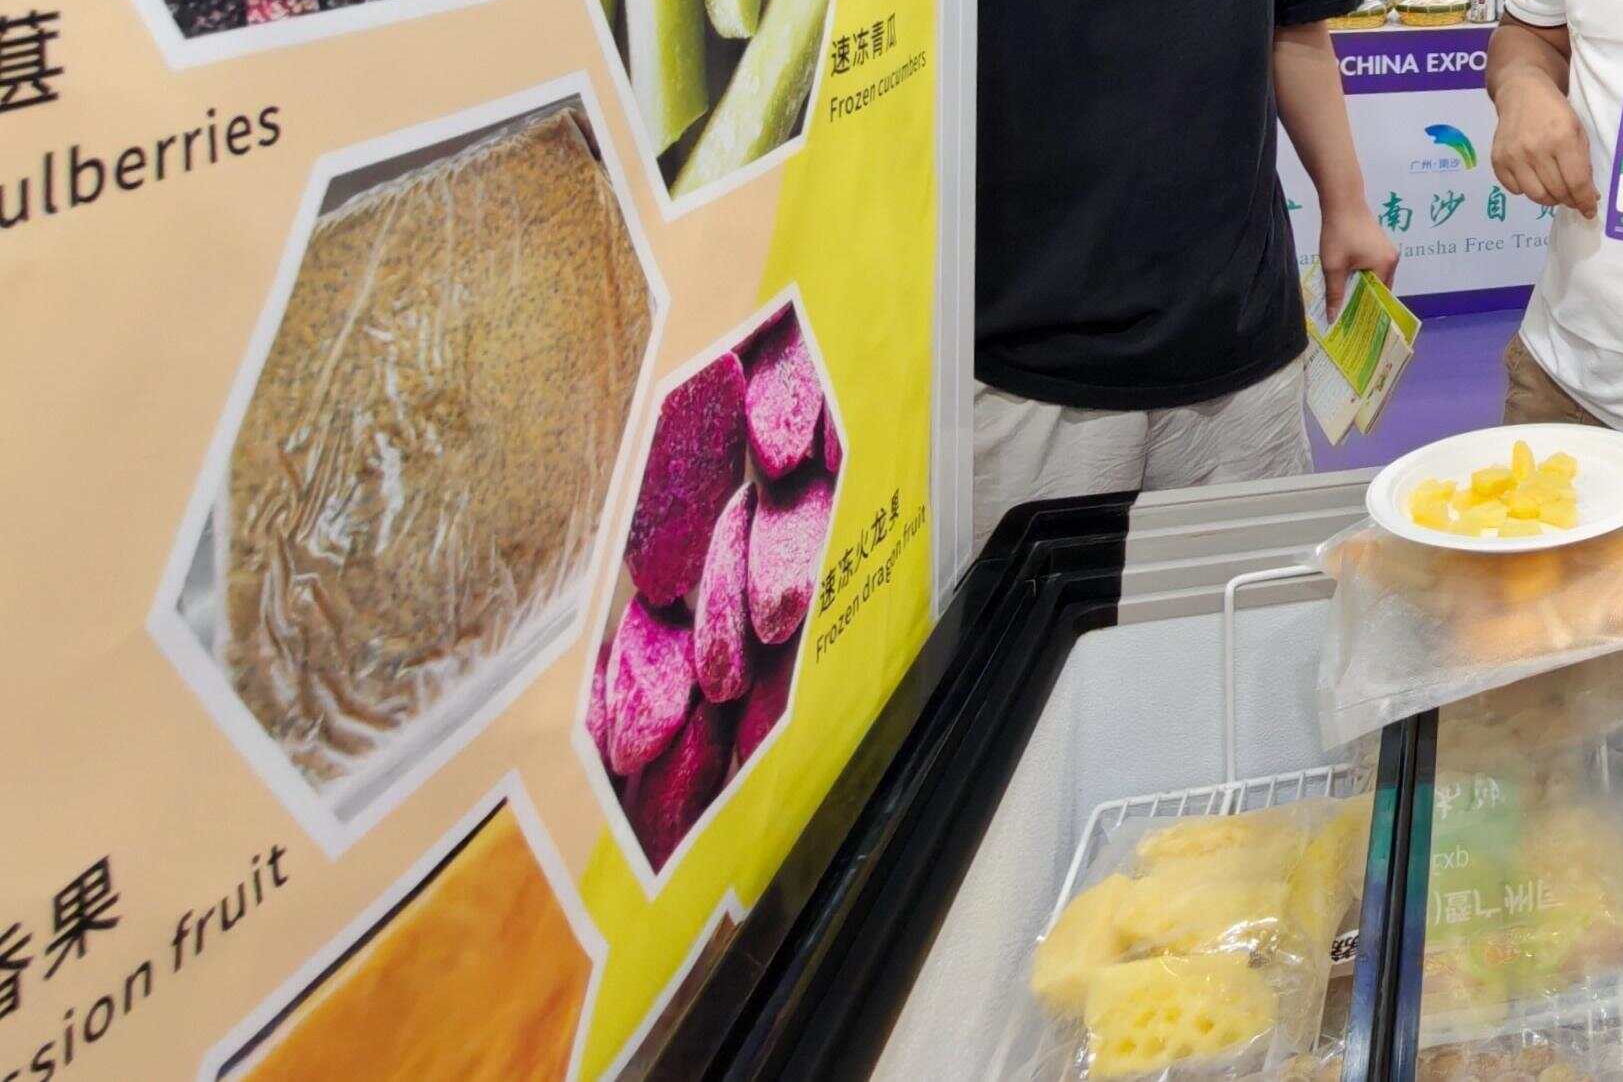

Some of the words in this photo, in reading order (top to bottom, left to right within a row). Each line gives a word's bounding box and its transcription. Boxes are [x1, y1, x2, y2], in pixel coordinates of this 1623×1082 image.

[830, 12, 898, 78] 速冻青瓜
[1337, 52, 1419, 76] CHINA
[1427, 50, 1487, 73] EXPO
[830, 84, 876, 123] Frozen
[877, 51, 927, 96] cucumbers
[1399, 235, 1457, 258] ansha
[1465, 237, 1505, 253] Free
[816, 595, 860, 664] Frozen
[862, 540, 902, 602] dragon
[903, 504, 926, 548] fruit
[818, 488, 900, 618] 速冻火龙果
[170, 844, 289, 973] fruit
